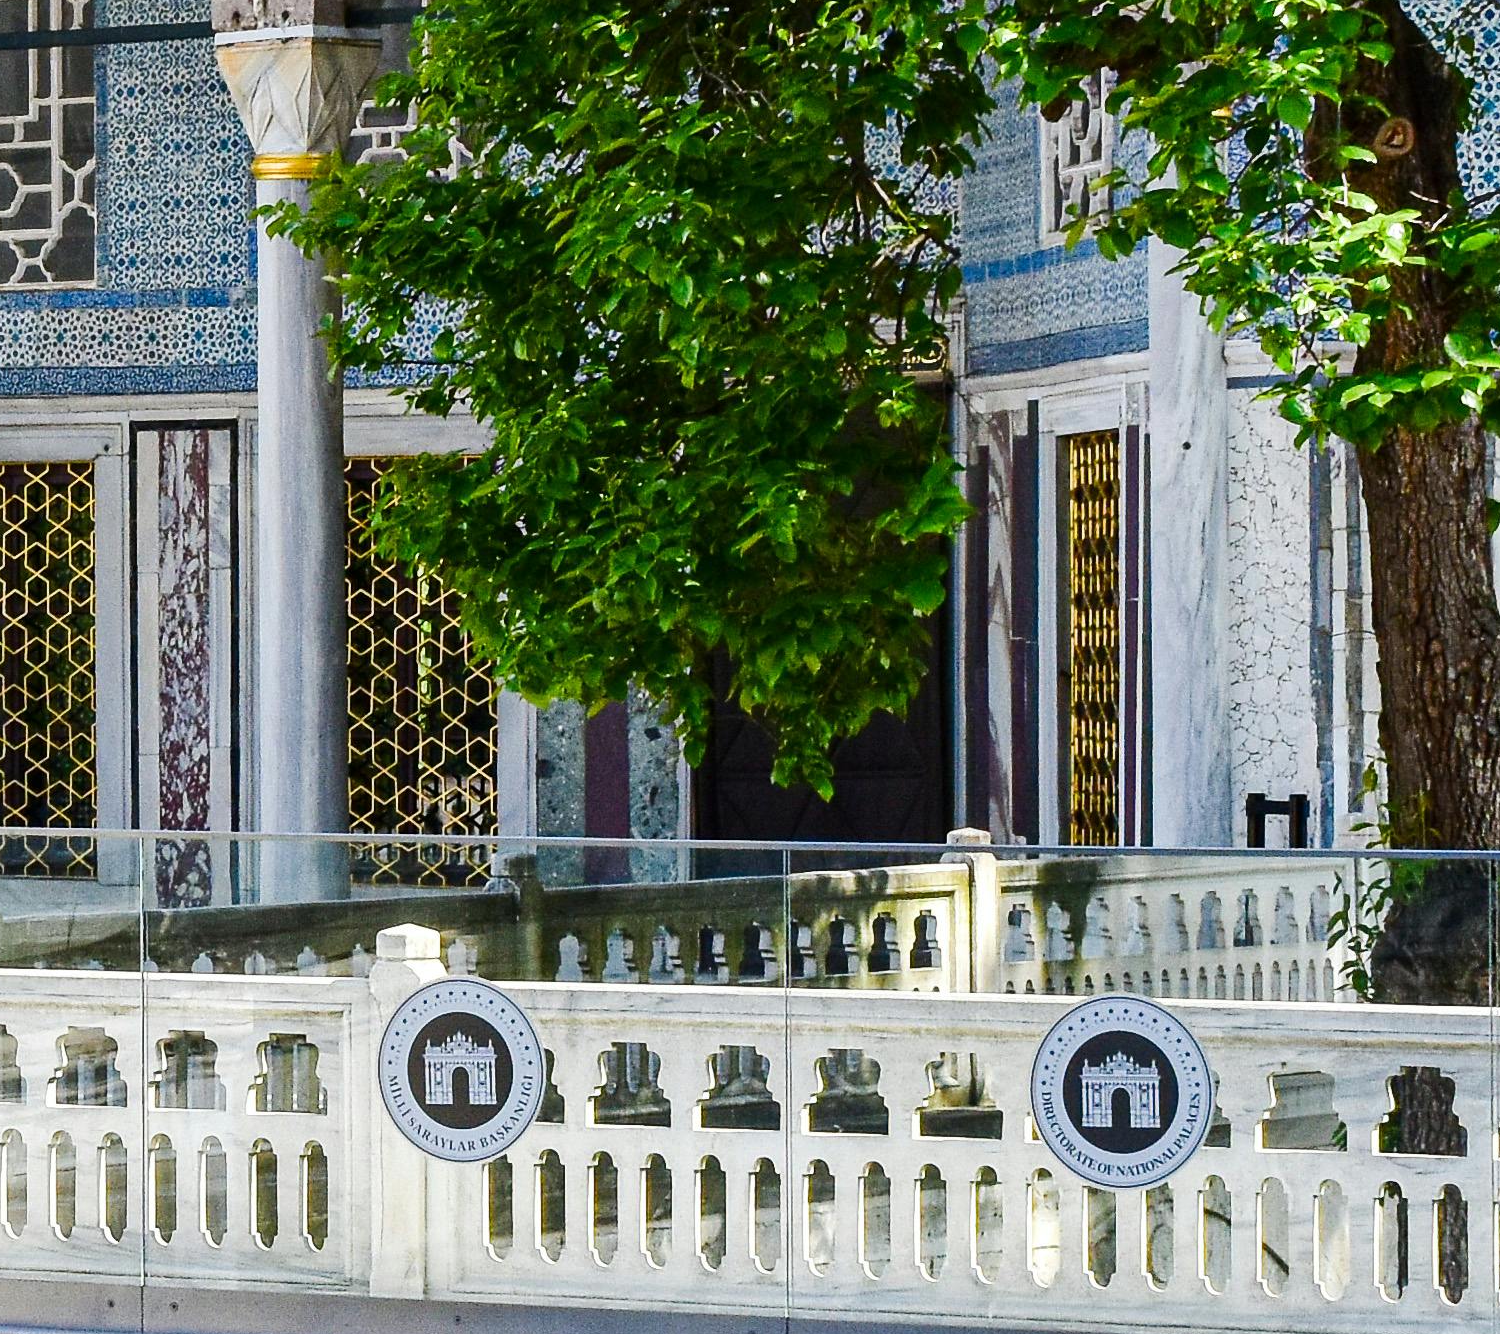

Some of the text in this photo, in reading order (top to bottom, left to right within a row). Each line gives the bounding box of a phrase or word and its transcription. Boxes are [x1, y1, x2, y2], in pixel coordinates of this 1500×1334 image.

[388, 1074, 533, 1151] MİLLİ SARAYLAR BAŞKANLIĞI
[1041, 1092, 1201, 1177] DIRECTORATE OF NATIONAL PALACES
